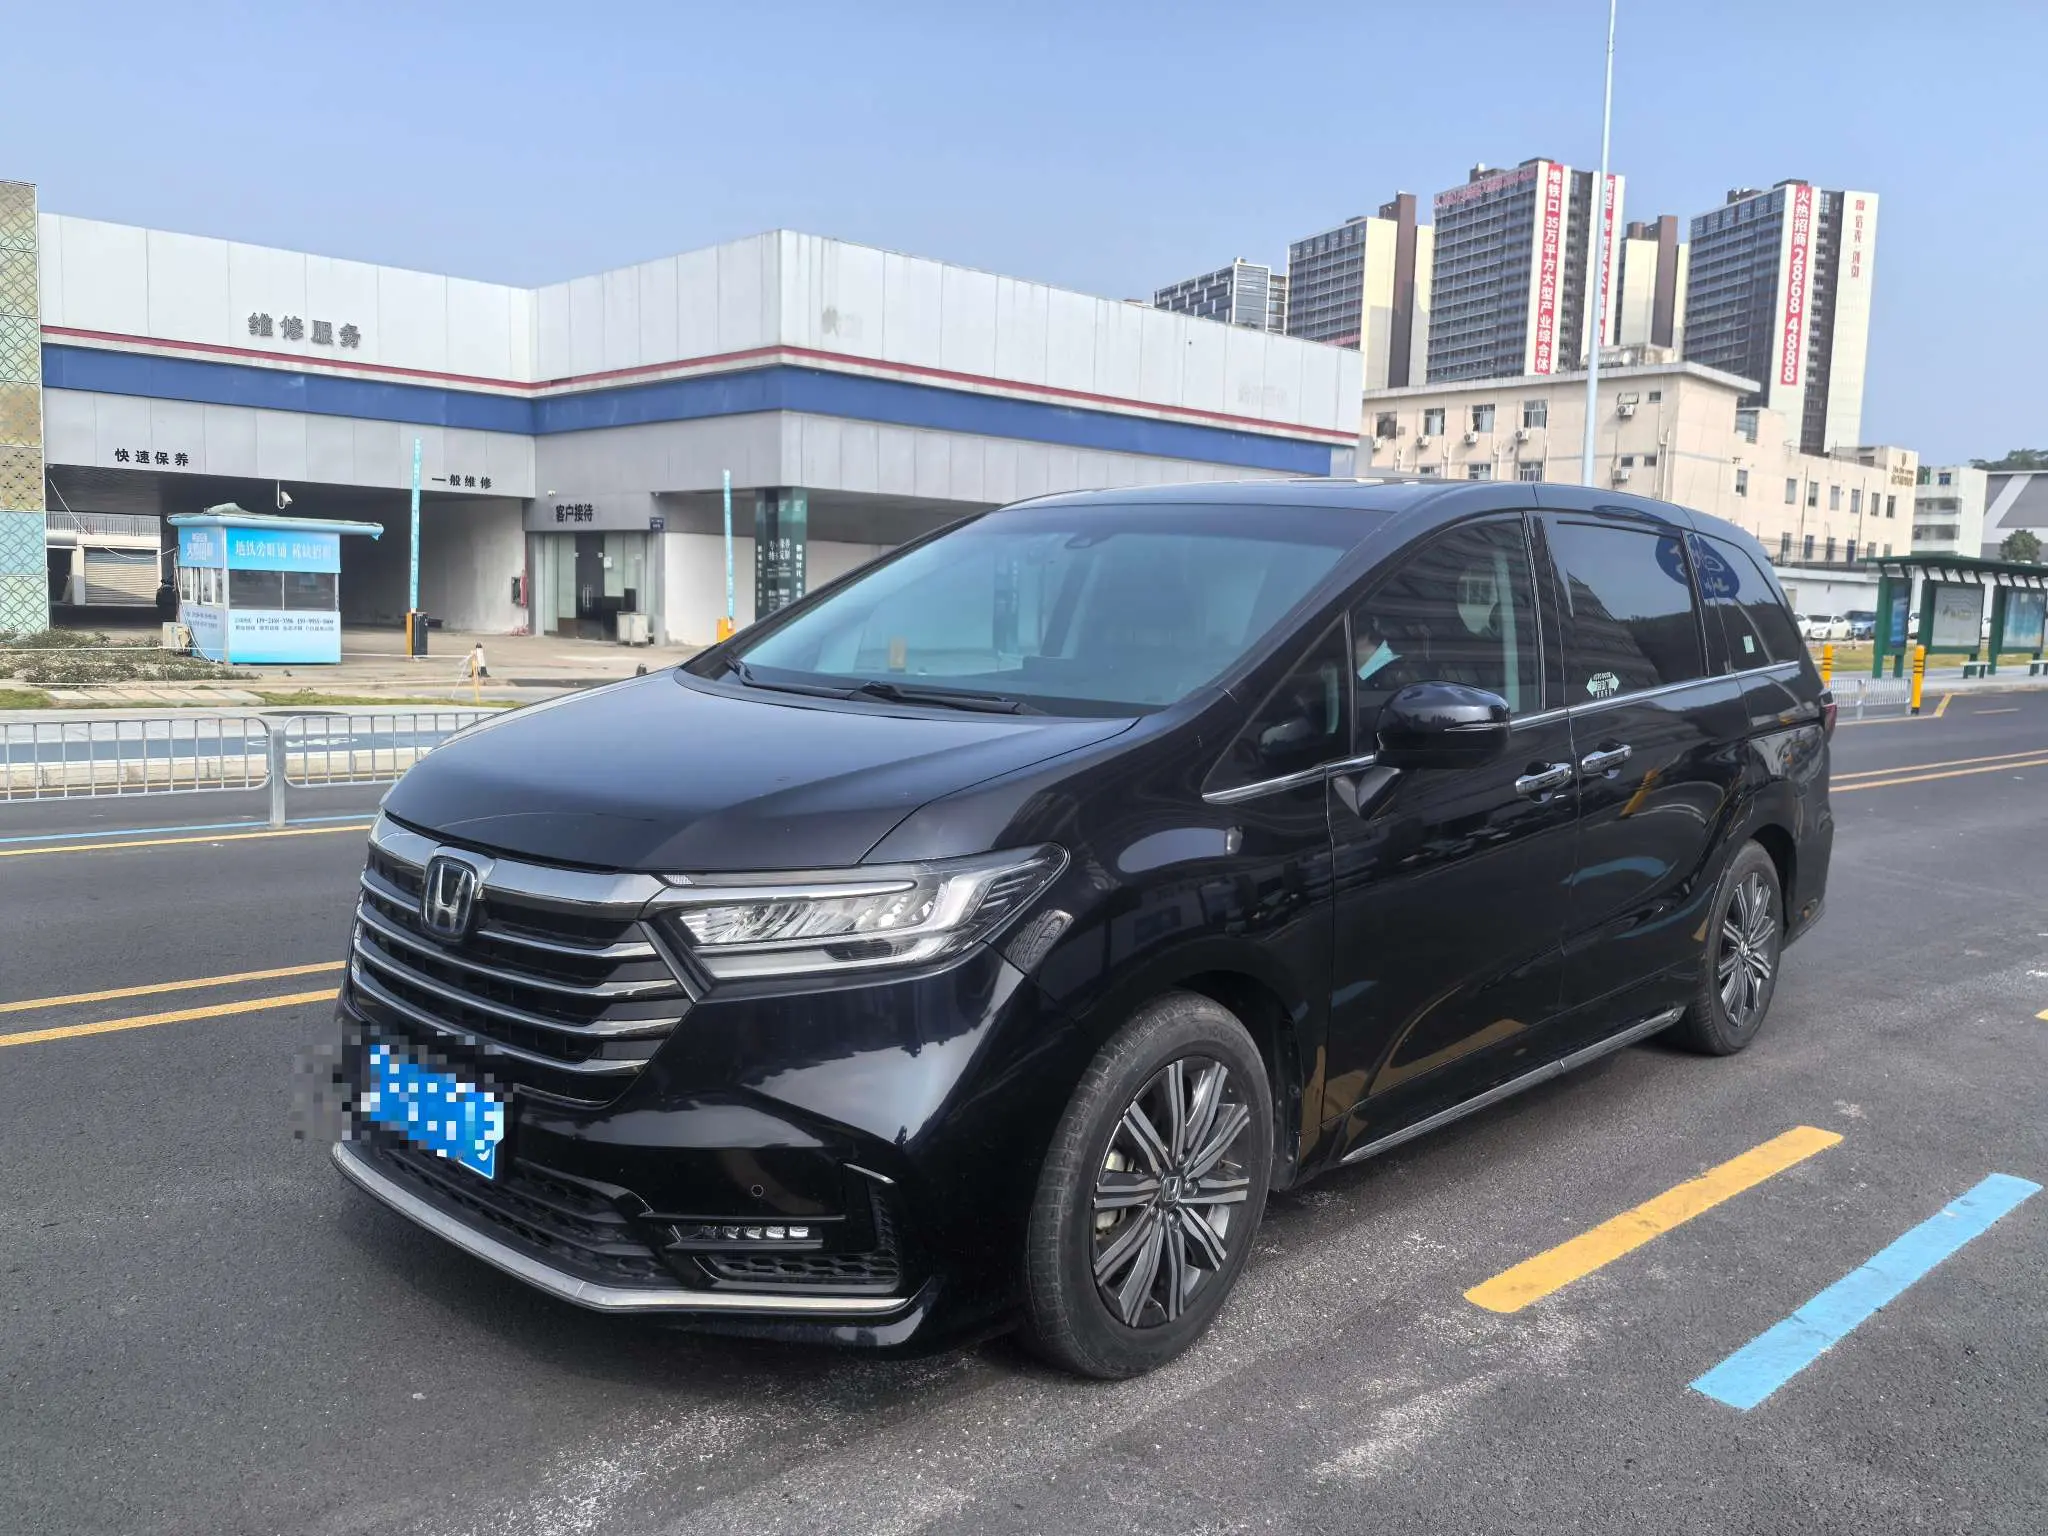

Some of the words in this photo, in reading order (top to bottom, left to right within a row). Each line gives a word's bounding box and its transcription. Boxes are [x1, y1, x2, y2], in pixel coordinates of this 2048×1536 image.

[1547, 170, 1562, 213] 地铁口
[1793, 191, 1810, 246] 火热招商
[1790, 249, 1804, 313] 2868
[248, 312, 361, 348] 维修服务
[1784, 317, 1799, 383] 4888
[114, 448, 189, 466] 快速保养
[431, 474, 492, 490] 一般维修
[556, 503, 593, 523] 客户接待
